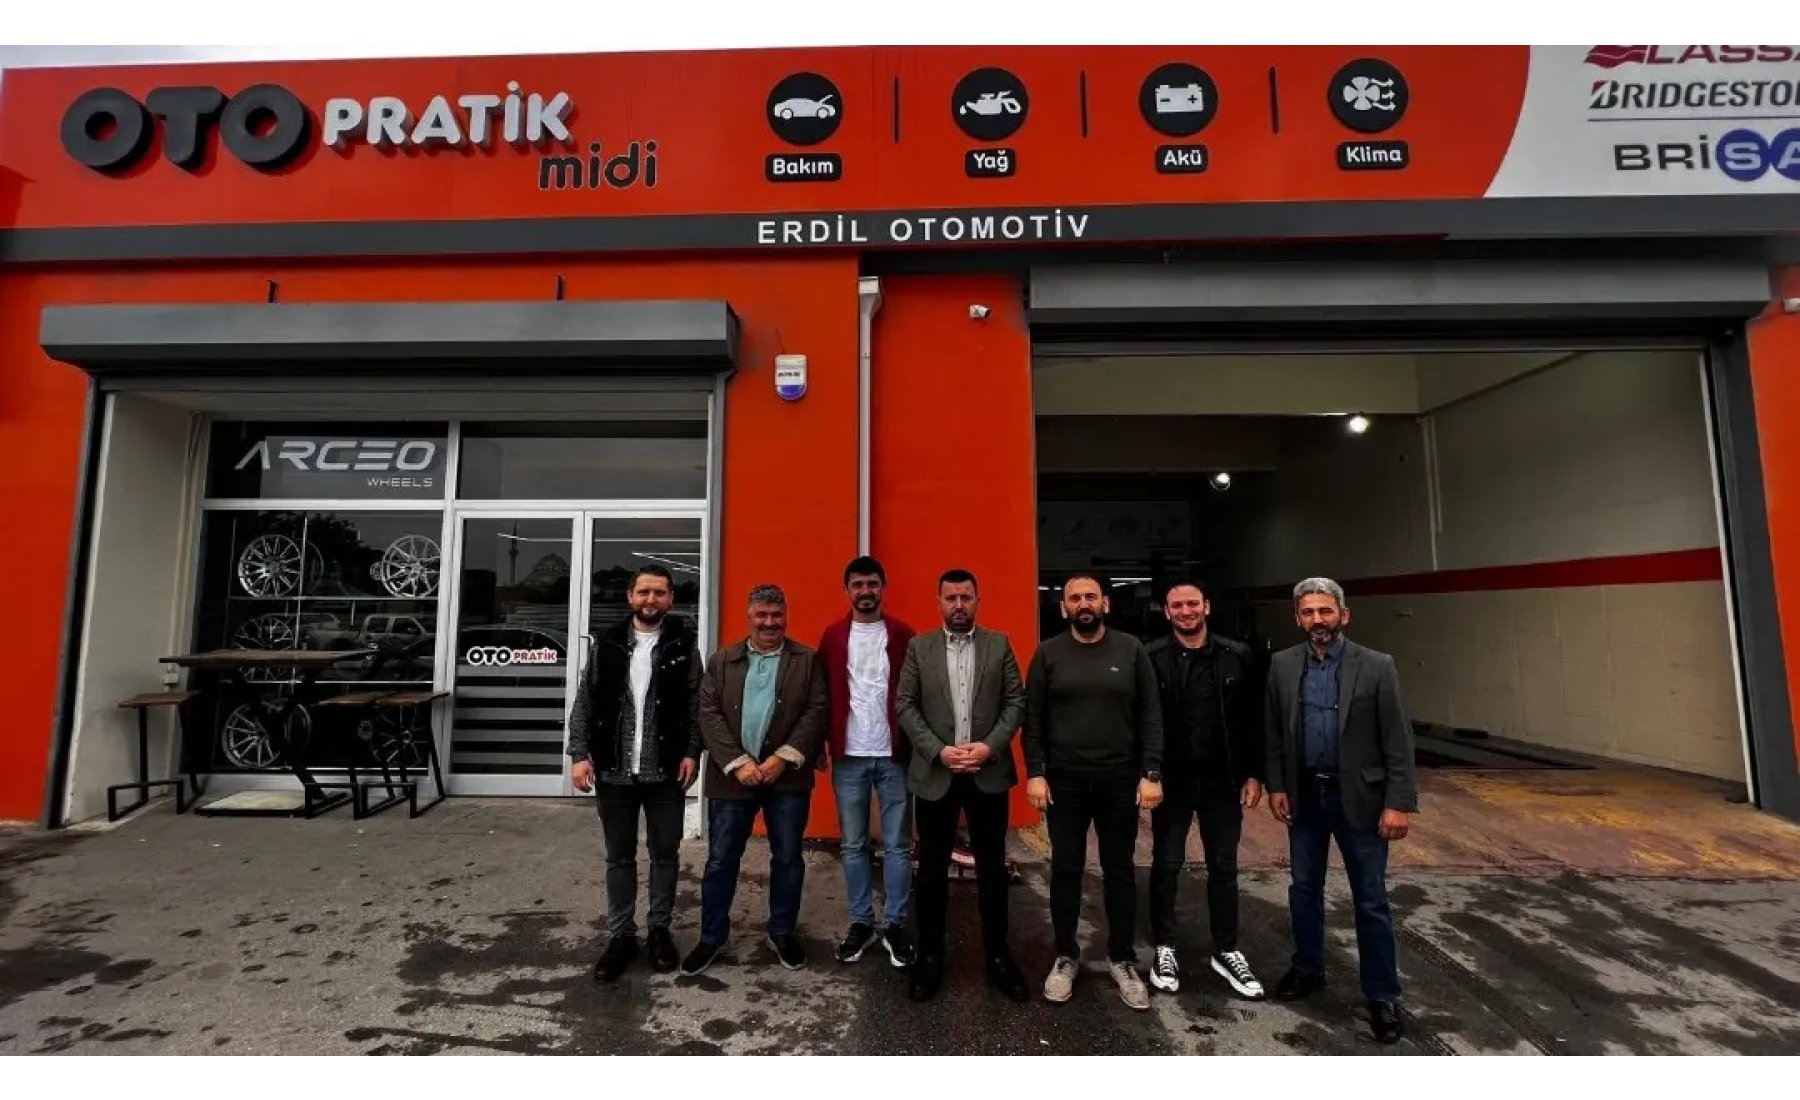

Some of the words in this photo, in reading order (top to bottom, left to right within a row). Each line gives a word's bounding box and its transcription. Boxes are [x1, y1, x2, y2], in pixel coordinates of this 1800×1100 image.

[1646, 45, 1800, 64] LASS
[1589, 79, 1800, 108] BRIDGESTO
[60, 84, 311, 175] OTO
[323, 81, 571, 148] PRATİK
[539, 141, 658, 189] midi
[973, 150, 1010, 173] Yağ
[1163, 149, 1203, 167] Akü
[1346, 145, 1402, 165] Klima
[772, 157, 833, 176] Bakım
[757, 215, 868, 245] ERDİL
[889, 209, 1089, 242] OTOMOTİV
[234, 440, 436, 471] ARCEO
[367, 477, 433, 488] WHEELS
[467, 646, 512, 666] OTO
[512, 647, 557, 664] PRATİK
